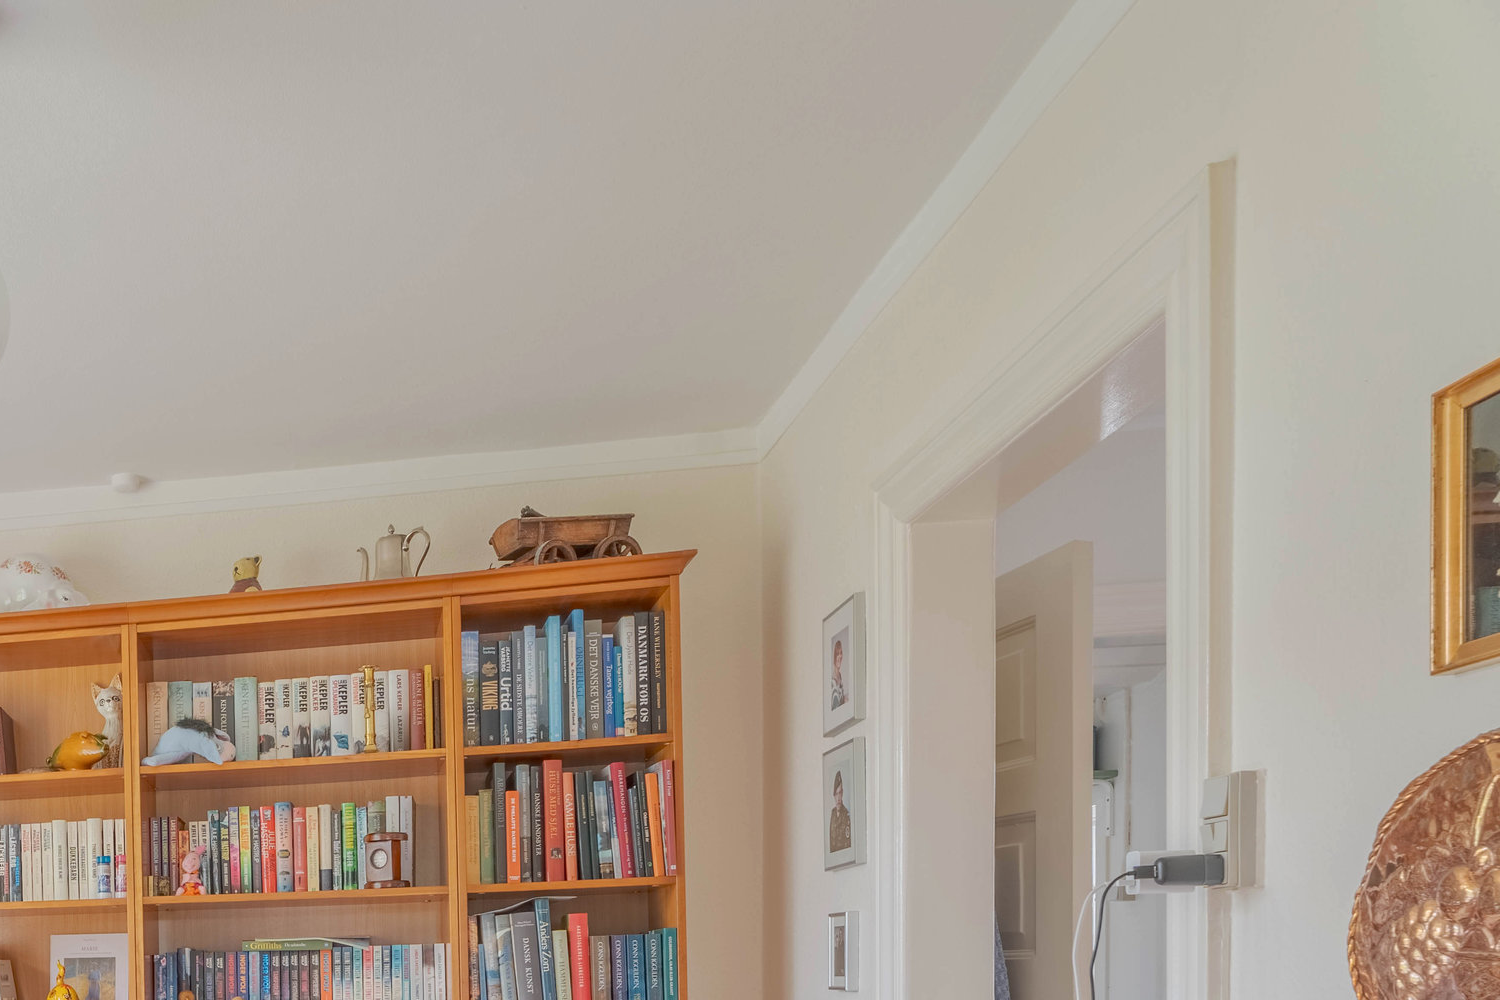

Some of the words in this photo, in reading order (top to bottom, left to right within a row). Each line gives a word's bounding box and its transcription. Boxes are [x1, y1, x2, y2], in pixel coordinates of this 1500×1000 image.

[589, 640, 598, 657] DET
[638, 626, 648, 681] DANMARK
[242, 684, 250, 699] KEN
[590, 660, 599, 697] DANSKE
[265, 691, 276, 724] KEPLER
[299, 686, 309, 713] KEPLER
[312, 680, 320, 711] STALKER
[320, 684, 328, 711] KEPLER
[338, 685, 349, 715] KEPLER
[376, 682, 385, 710] KEPLER
[482, 681, 498, 710] VIKING
[500, 677, 512, 711] Urtid
[242, 701, 250, 729] FOLLETT
[467, 697, 478, 732] natur
[590, 699, 599, 720] VEJR
[640, 708, 649, 723] OS
[549, 770, 557, 794] HUSE
[618, 769, 626, 814] HERREMANDEN
[549, 796, 558, 816] MED
[565, 793, 574, 828] GAMLE
[261, 823, 269, 859] HASTRUP
[550, 818, 558, 839] SJÆL
[567, 830, 576, 857] HUSE
[69, 847, 77, 881] DUKKEBARN
[539, 920, 549, 951] Anders
[522, 937, 531, 964] DANSK
[542, 951, 552, 973] Zorn
[524, 967, 535, 994] KUNST
[598, 961, 606, 991] IGGULDEN
